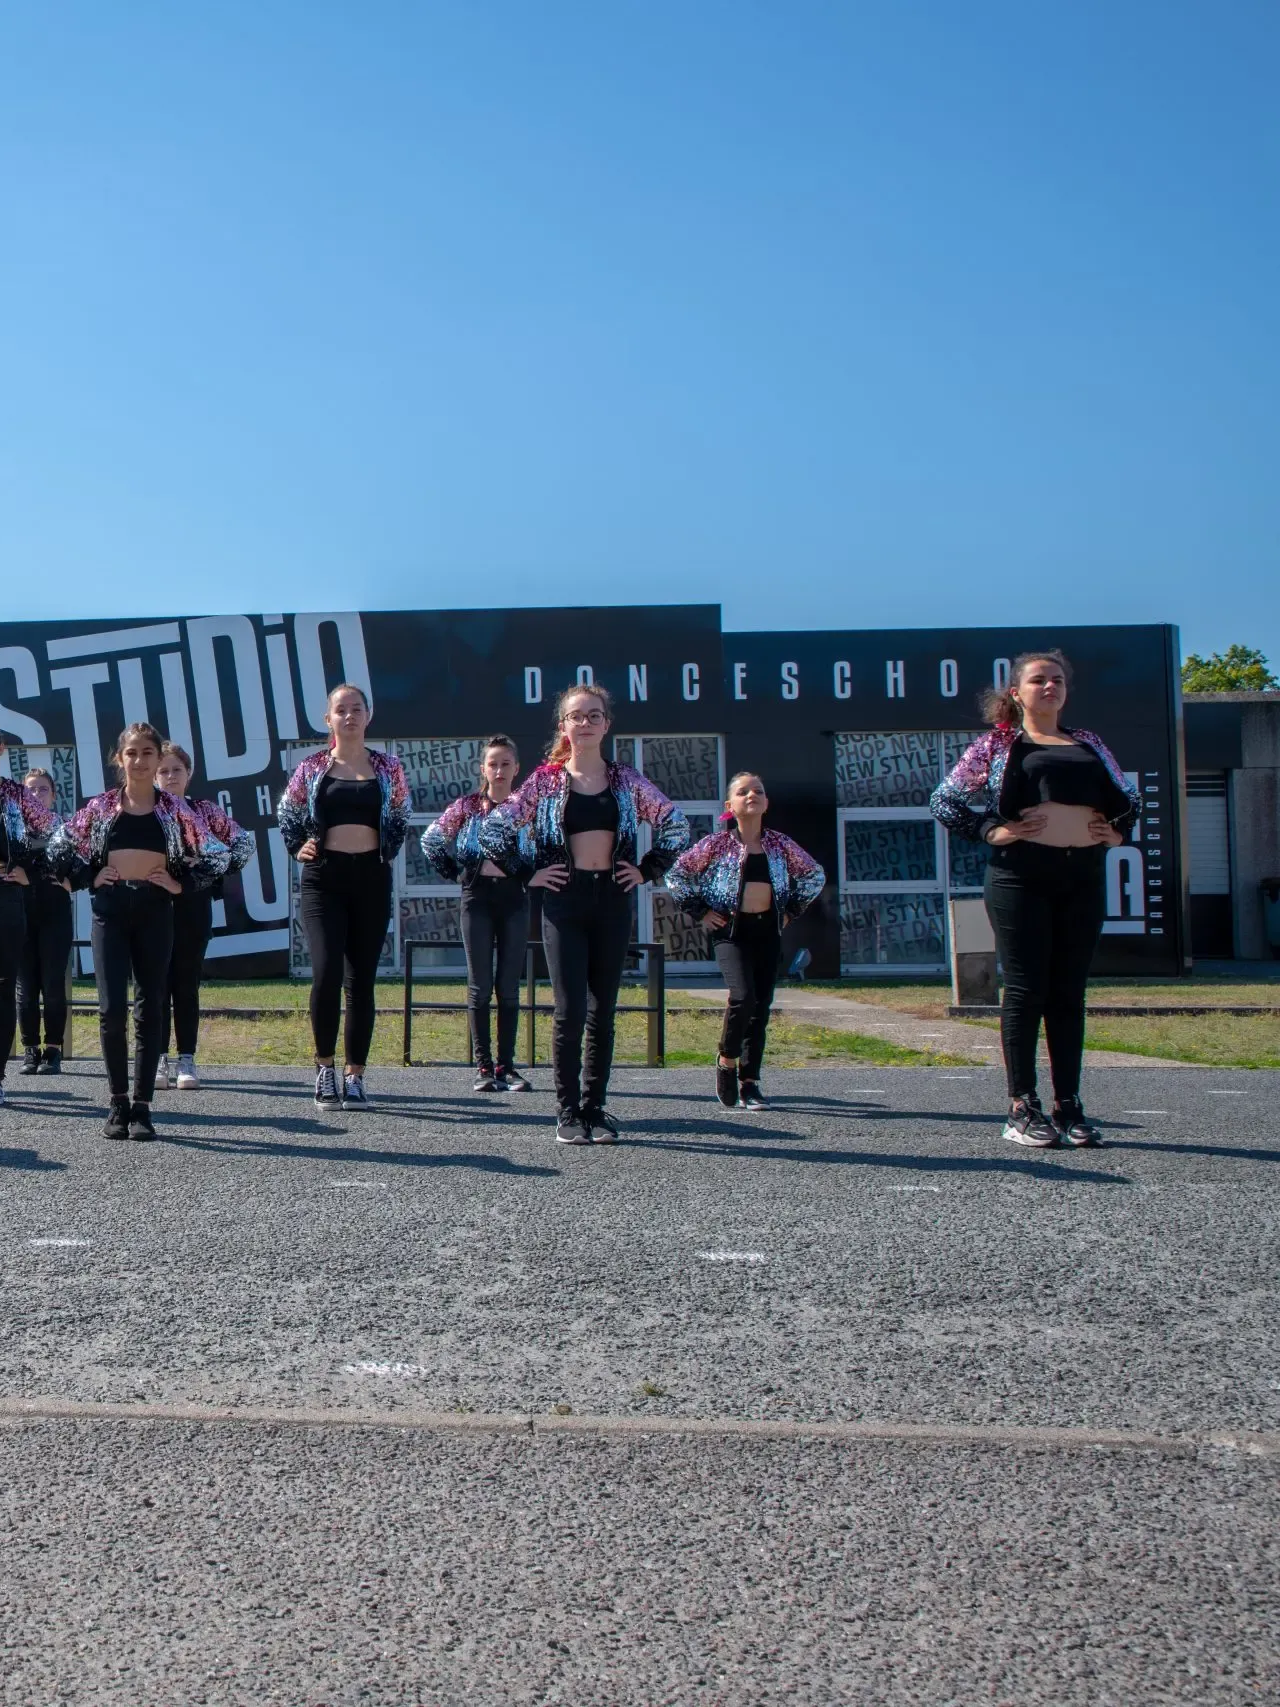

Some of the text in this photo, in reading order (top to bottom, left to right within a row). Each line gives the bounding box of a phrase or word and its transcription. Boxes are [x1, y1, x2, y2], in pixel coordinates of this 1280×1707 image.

[524, 660, 1011, 703] DANCESCHOO
[651, 739, 693, 761] NEW
[891, 733, 935, 755] NEW
[836, 760, 875, 783] NEW
[880, 749, 939, 775] STYLE
[433, 780, 472, 802] HOP
[877, 822, 935, 848] STYLE
[1145, 771, 1164, 935] DANCESCHOOL
[400, 897, 457, 917] STREE
[840, 898, 944, 932] NEW STYLE
